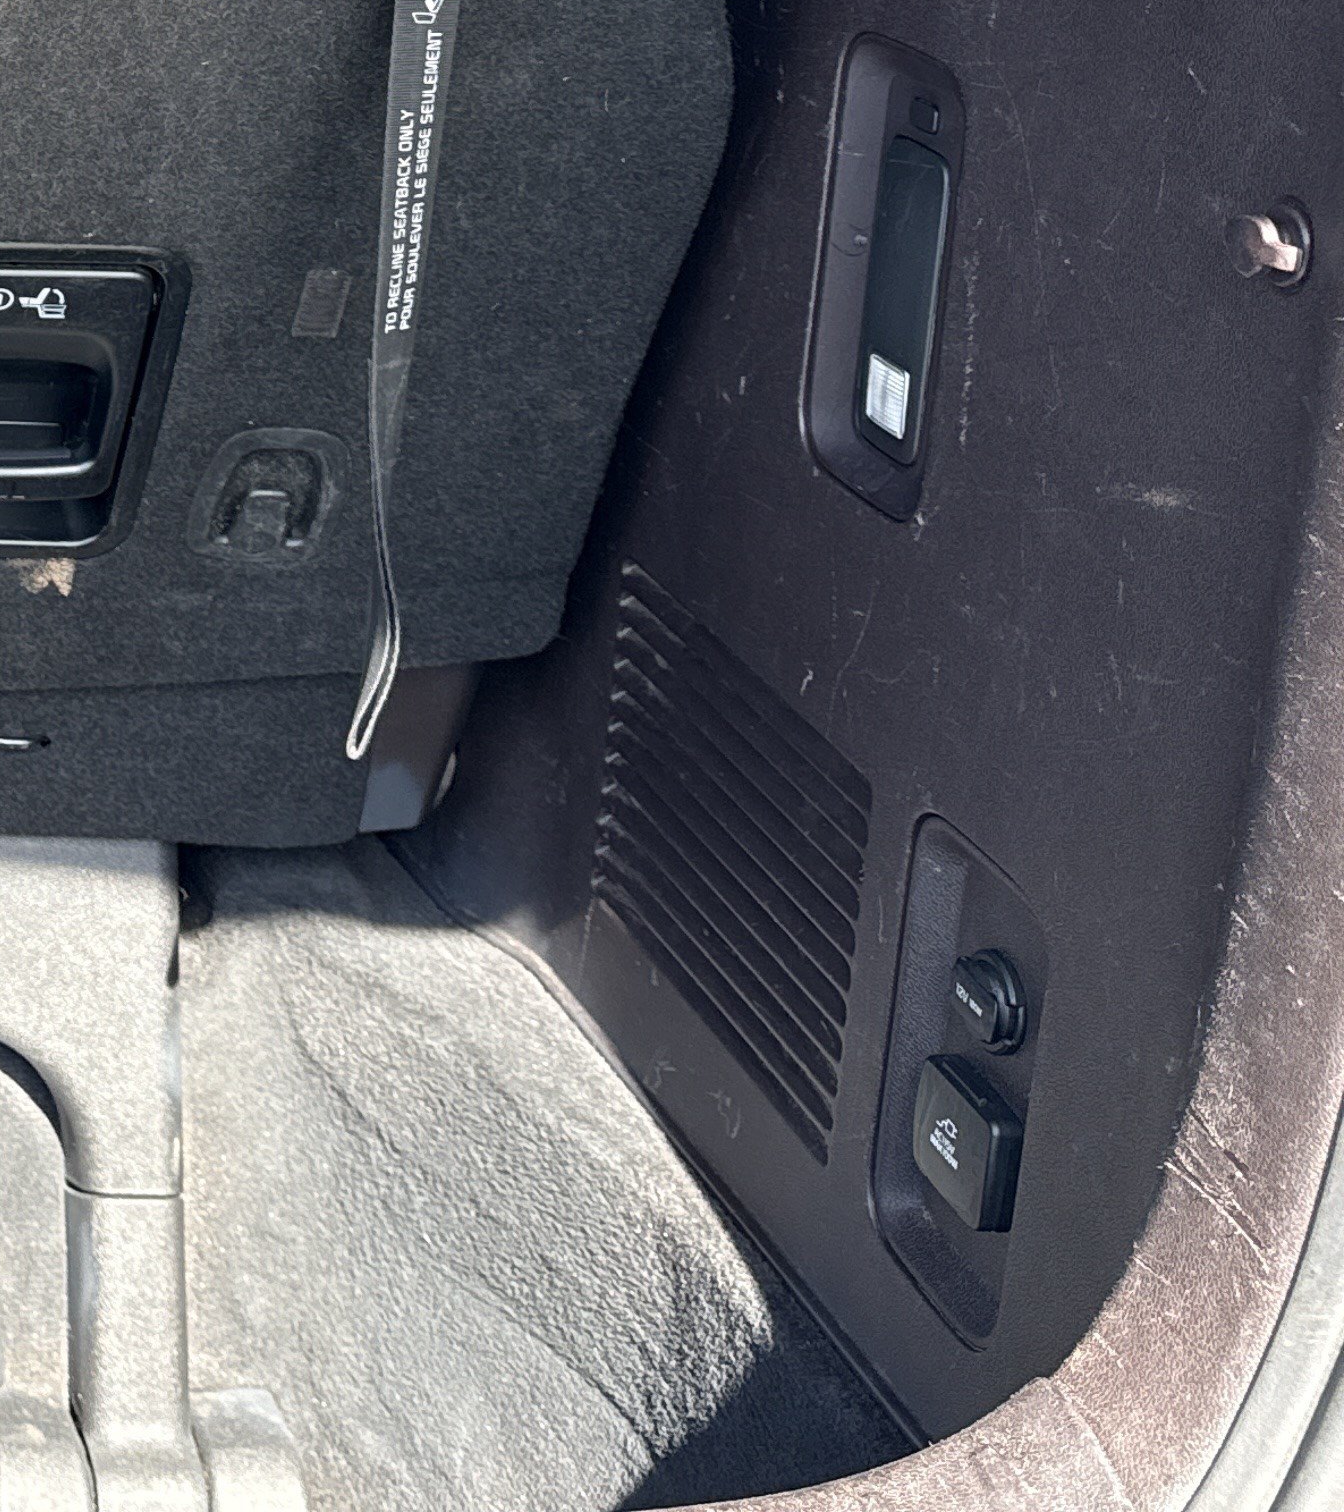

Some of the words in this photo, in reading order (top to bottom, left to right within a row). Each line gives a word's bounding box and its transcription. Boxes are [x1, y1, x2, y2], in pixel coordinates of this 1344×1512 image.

[419, 29, 444, 125] SEULEMENT
[398, 109, 415, 152] ONLY
[393, 156, 412, 239] SEATBACK
[414, 177, 427, 199] LE
[405, 201, 425, 285] SOULEVER
[387, 243, 405, 309] RECLINE
[385, 311, 397, 334] TO
[399, 287, 416, 331] POUR
